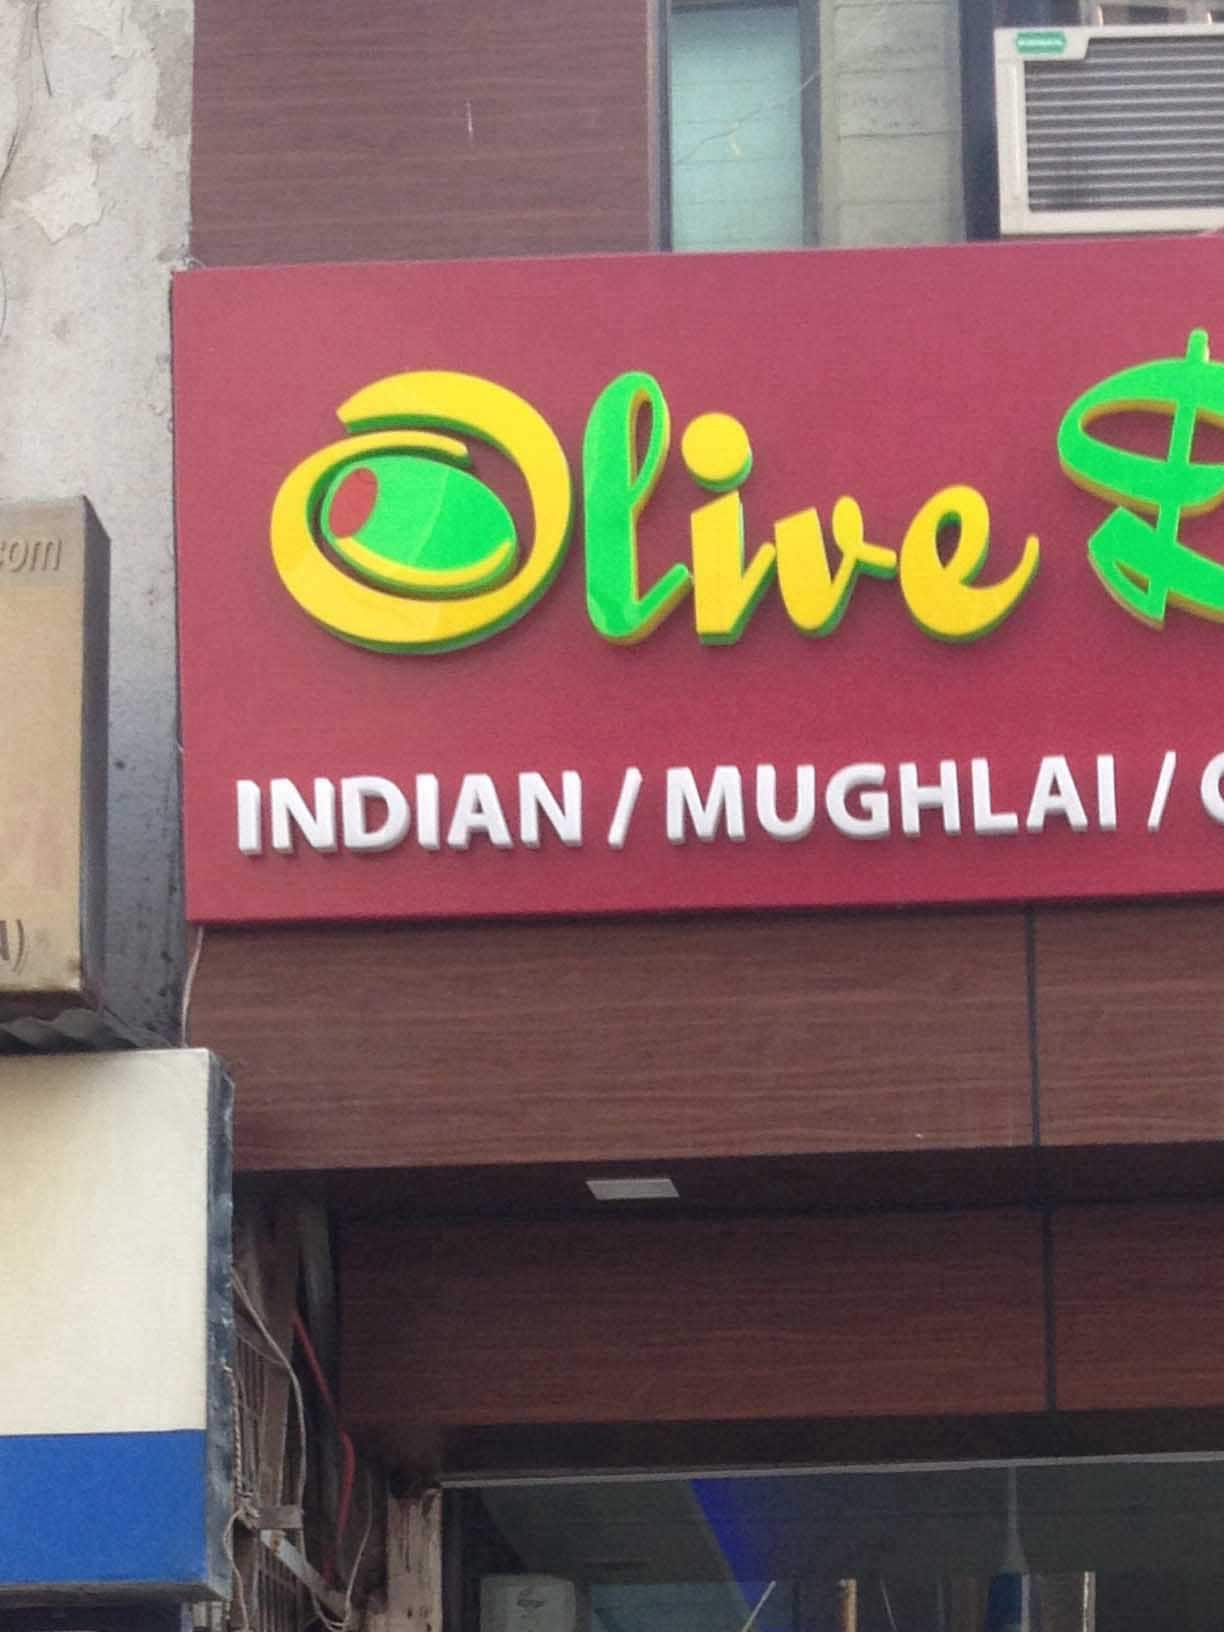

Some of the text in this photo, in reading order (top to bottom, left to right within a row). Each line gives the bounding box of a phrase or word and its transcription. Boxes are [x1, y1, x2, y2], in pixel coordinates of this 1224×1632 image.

[270, 370, 1040, 654] Olive
[236, 769, 583, 855] INDIAN
[666, 752, 1118, 846] MUGHLAI
